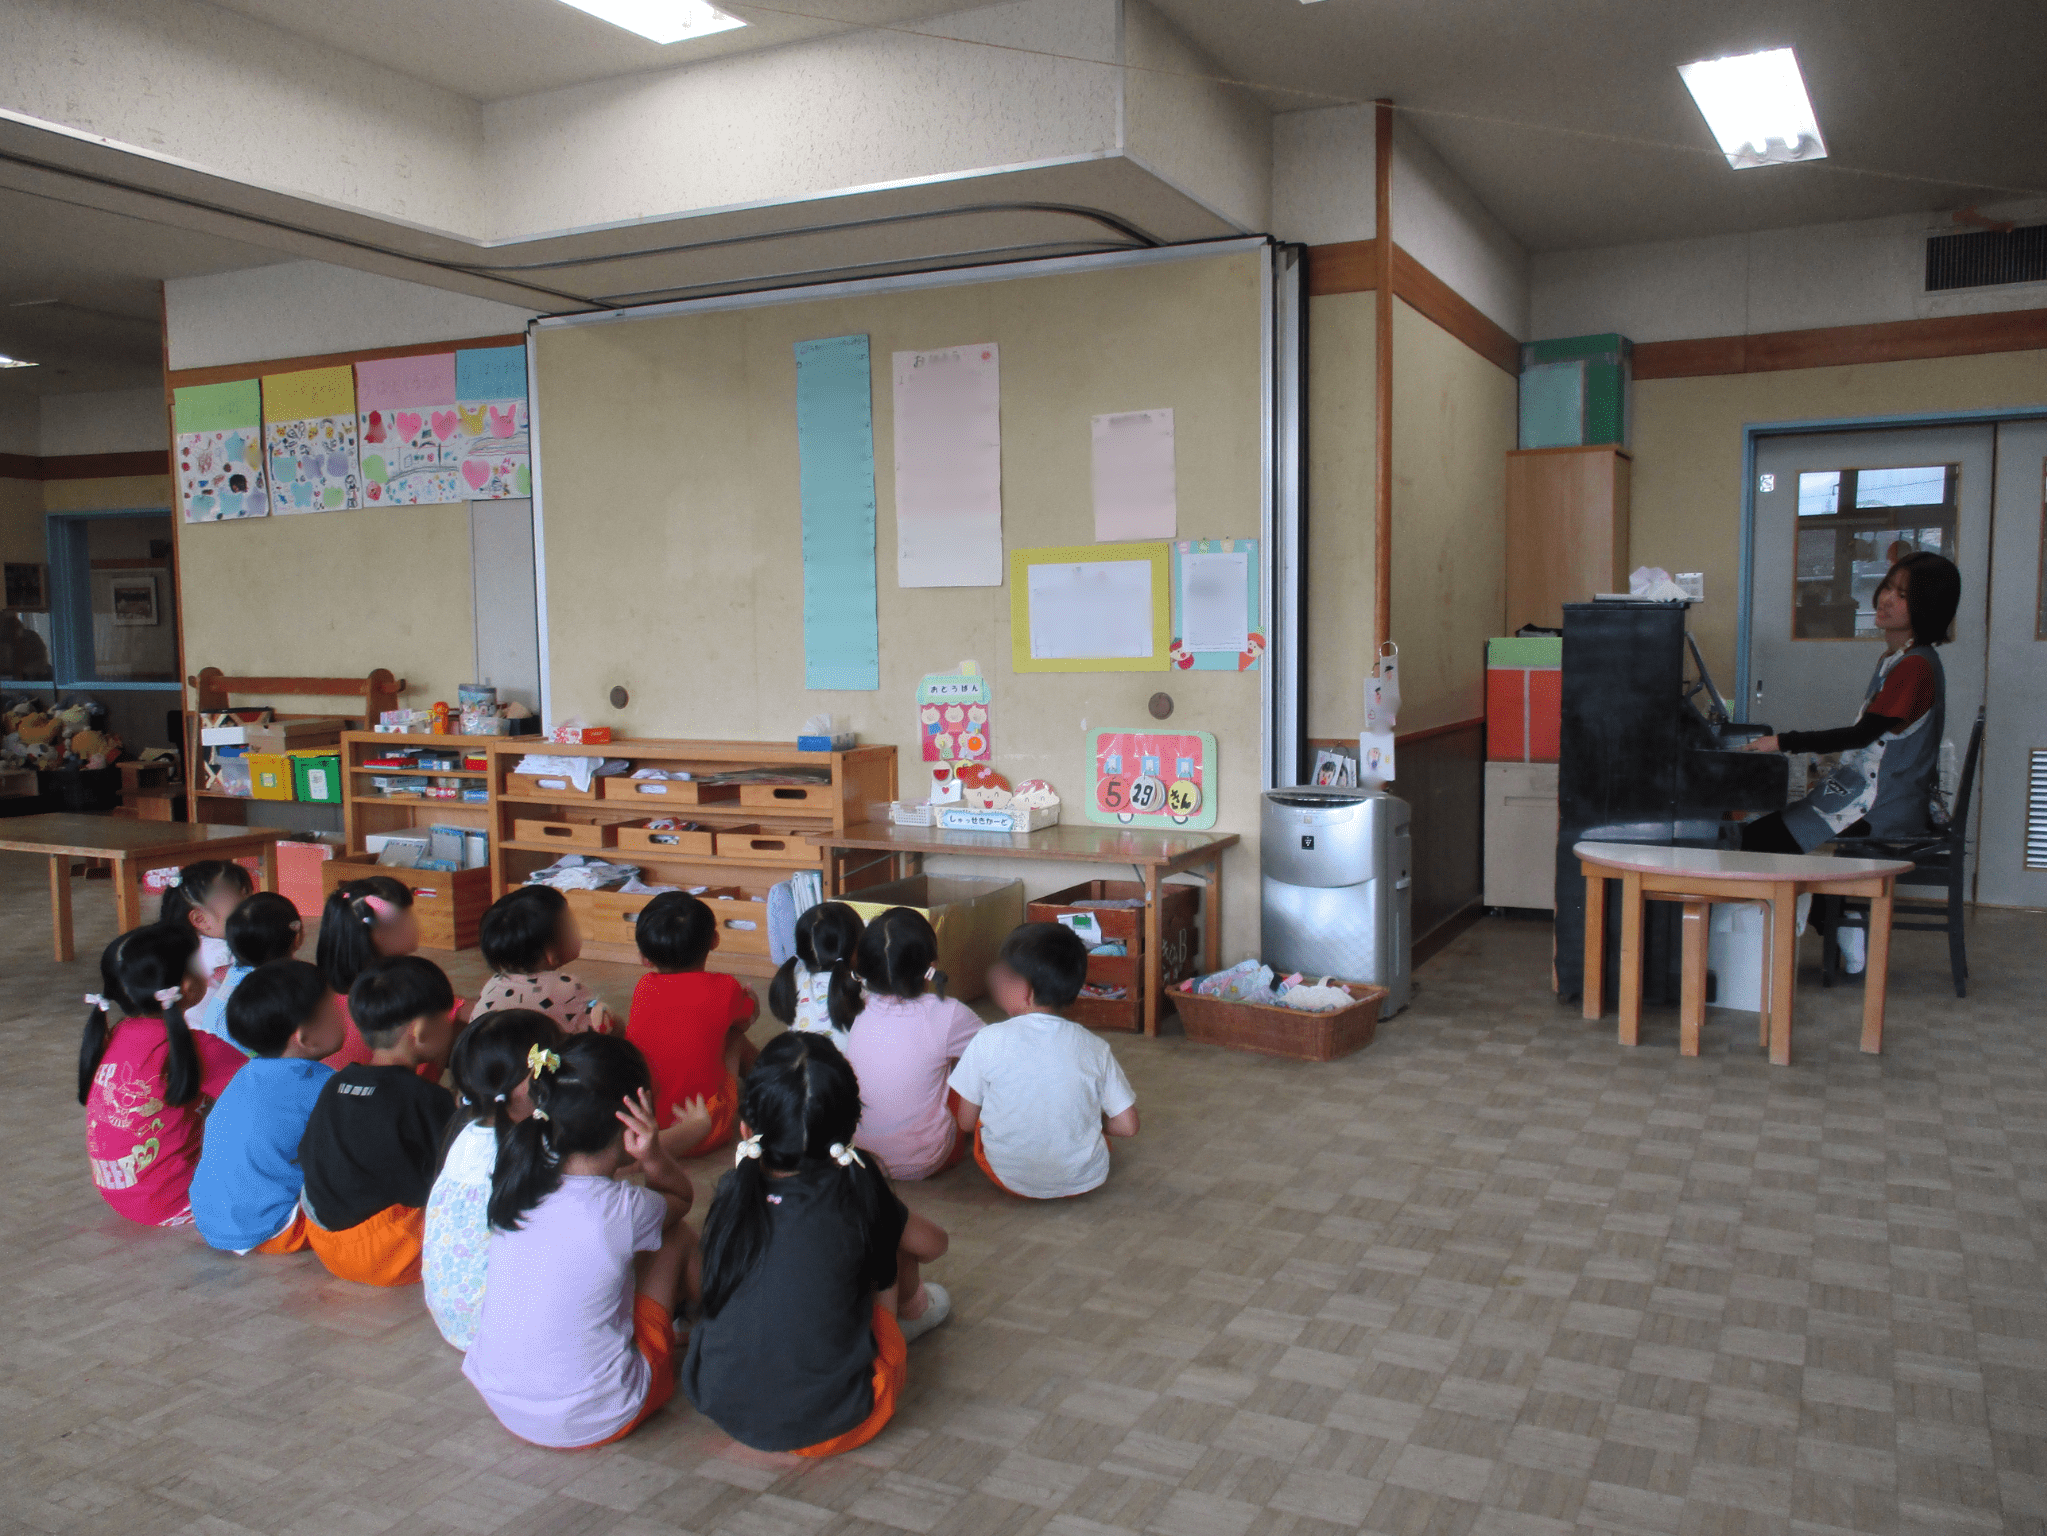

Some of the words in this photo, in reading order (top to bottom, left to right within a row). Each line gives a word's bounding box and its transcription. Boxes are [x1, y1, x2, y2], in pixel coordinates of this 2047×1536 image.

[930, 684, 978, 694] おとうばん
[1105, 781, 1121, 807] 5
[1131, 783, 1153, 806] 29
